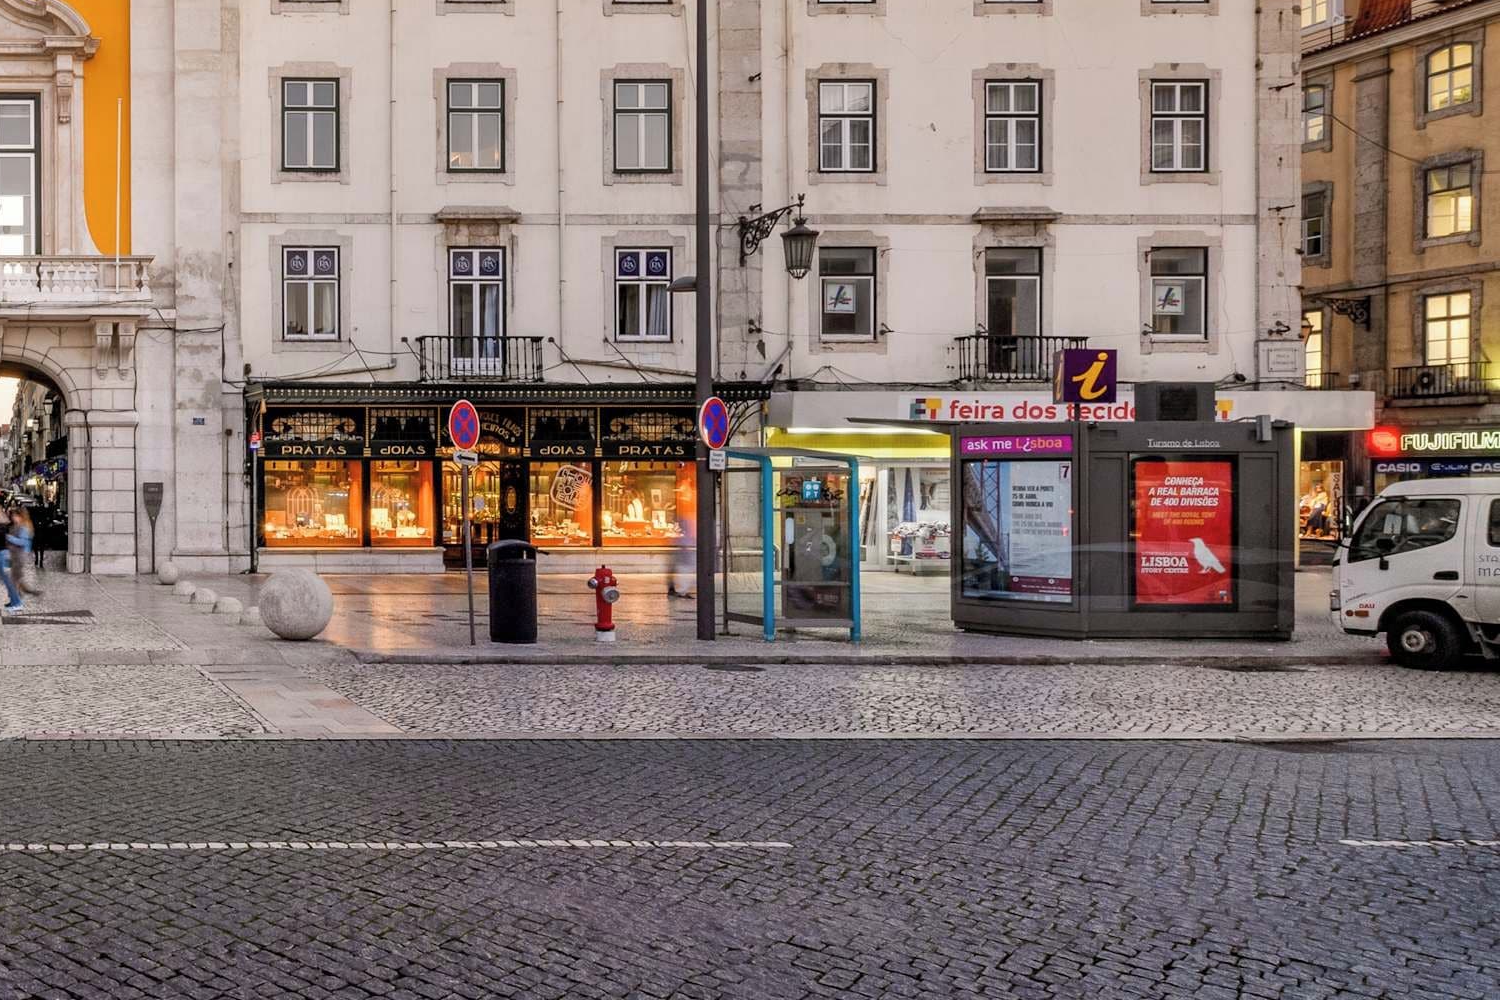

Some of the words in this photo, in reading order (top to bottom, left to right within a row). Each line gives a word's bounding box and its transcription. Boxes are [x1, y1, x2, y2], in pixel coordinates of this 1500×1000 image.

[949, 400, 1004, 420] feira
[1012, 400, 1056, 420] dos
[967, 438, 989, 450] ask
[992, 439, 1012, 450] me
[1147, 438, 1181, 448] Turismo
[1182, 439, 1194, 448] de
[1194, 438, 1220, 448] Lisboa
[1400, 431, 1500, 451] FUJIFILM
[281, 445, 347, 455] PRATAS
[619, 445, 685, 455] PRATAS
[1061, 465, 1070, 479] 7
[1377, 463, 1420, 472] CASIO
[1164, 477, 1204, 488] CONHEÇA
[1148, 487, 1155, 496] A
[1157, 487, 1178, 496] REAL
[1180, 487, 1219, 496] BARRACA
[1150, 497, 1162, 506] DE
[1164, 497, 1178, 506] 400
[1180, 496, 1219, 506] DIVISÕES
[1141, 556, 1188, 567] LISBOA
